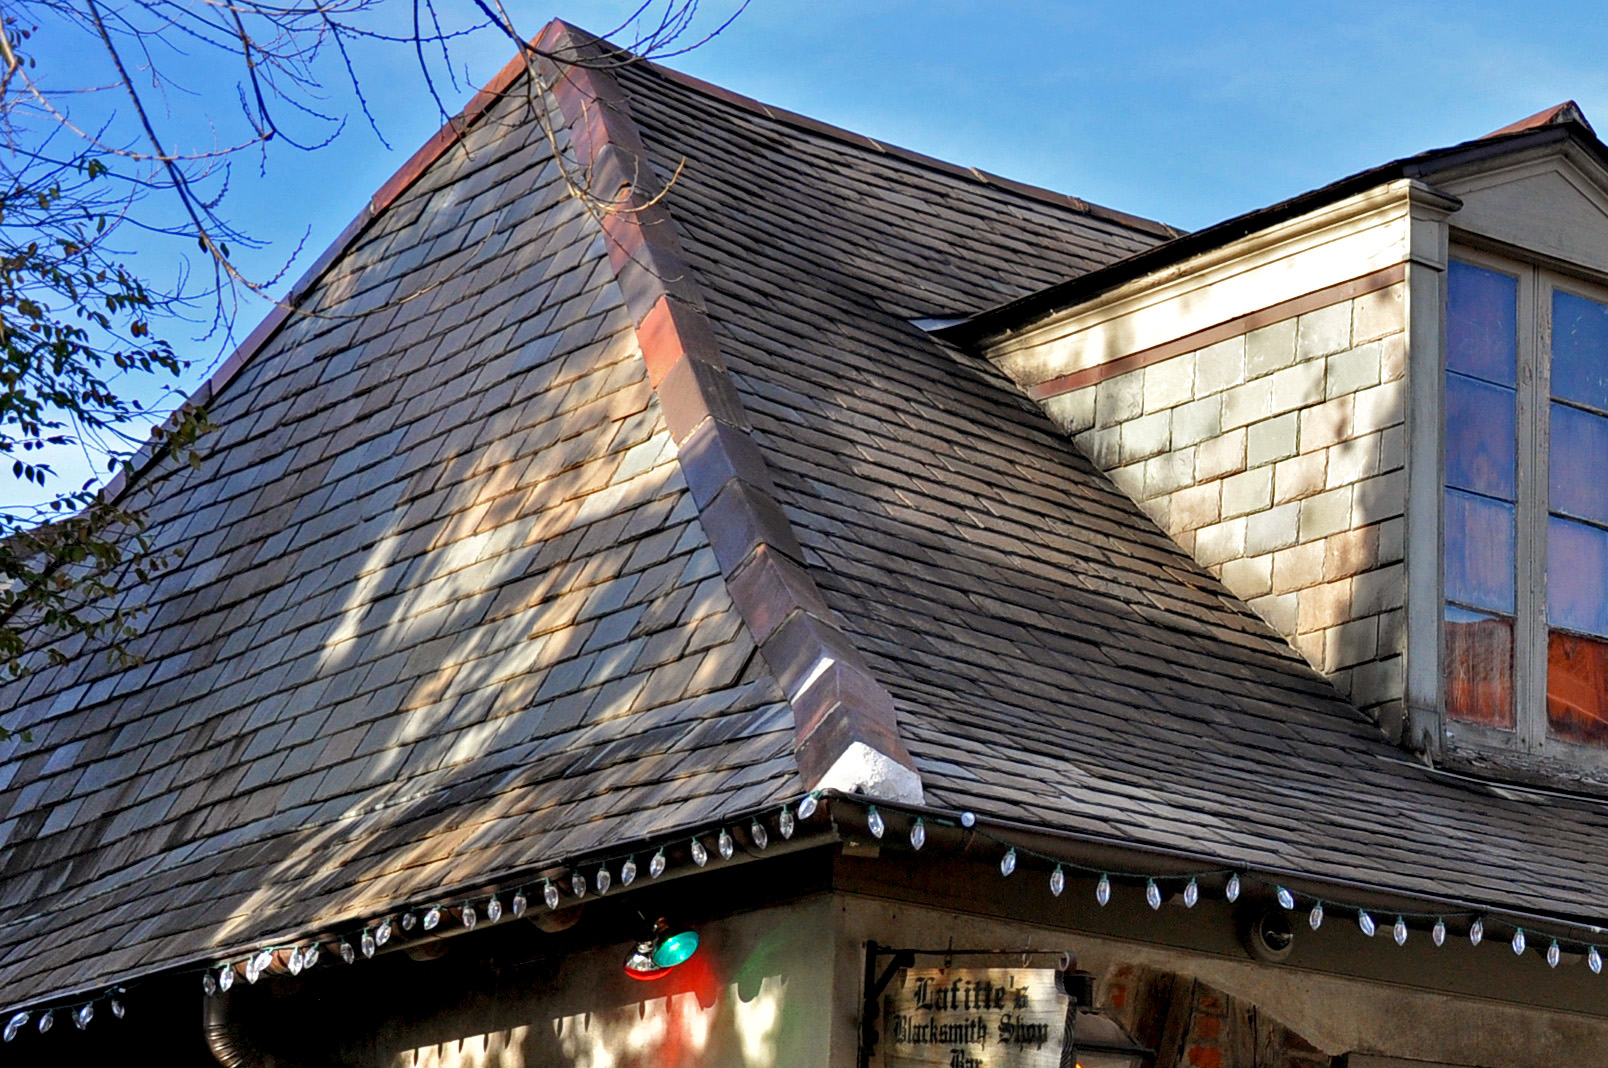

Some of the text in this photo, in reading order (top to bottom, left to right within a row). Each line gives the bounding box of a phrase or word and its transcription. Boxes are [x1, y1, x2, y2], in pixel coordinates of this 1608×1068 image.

[914, 975, 1030, 1012] Lafitte's
[893, 1012, 1049, 1052] Blacksmith Shop
